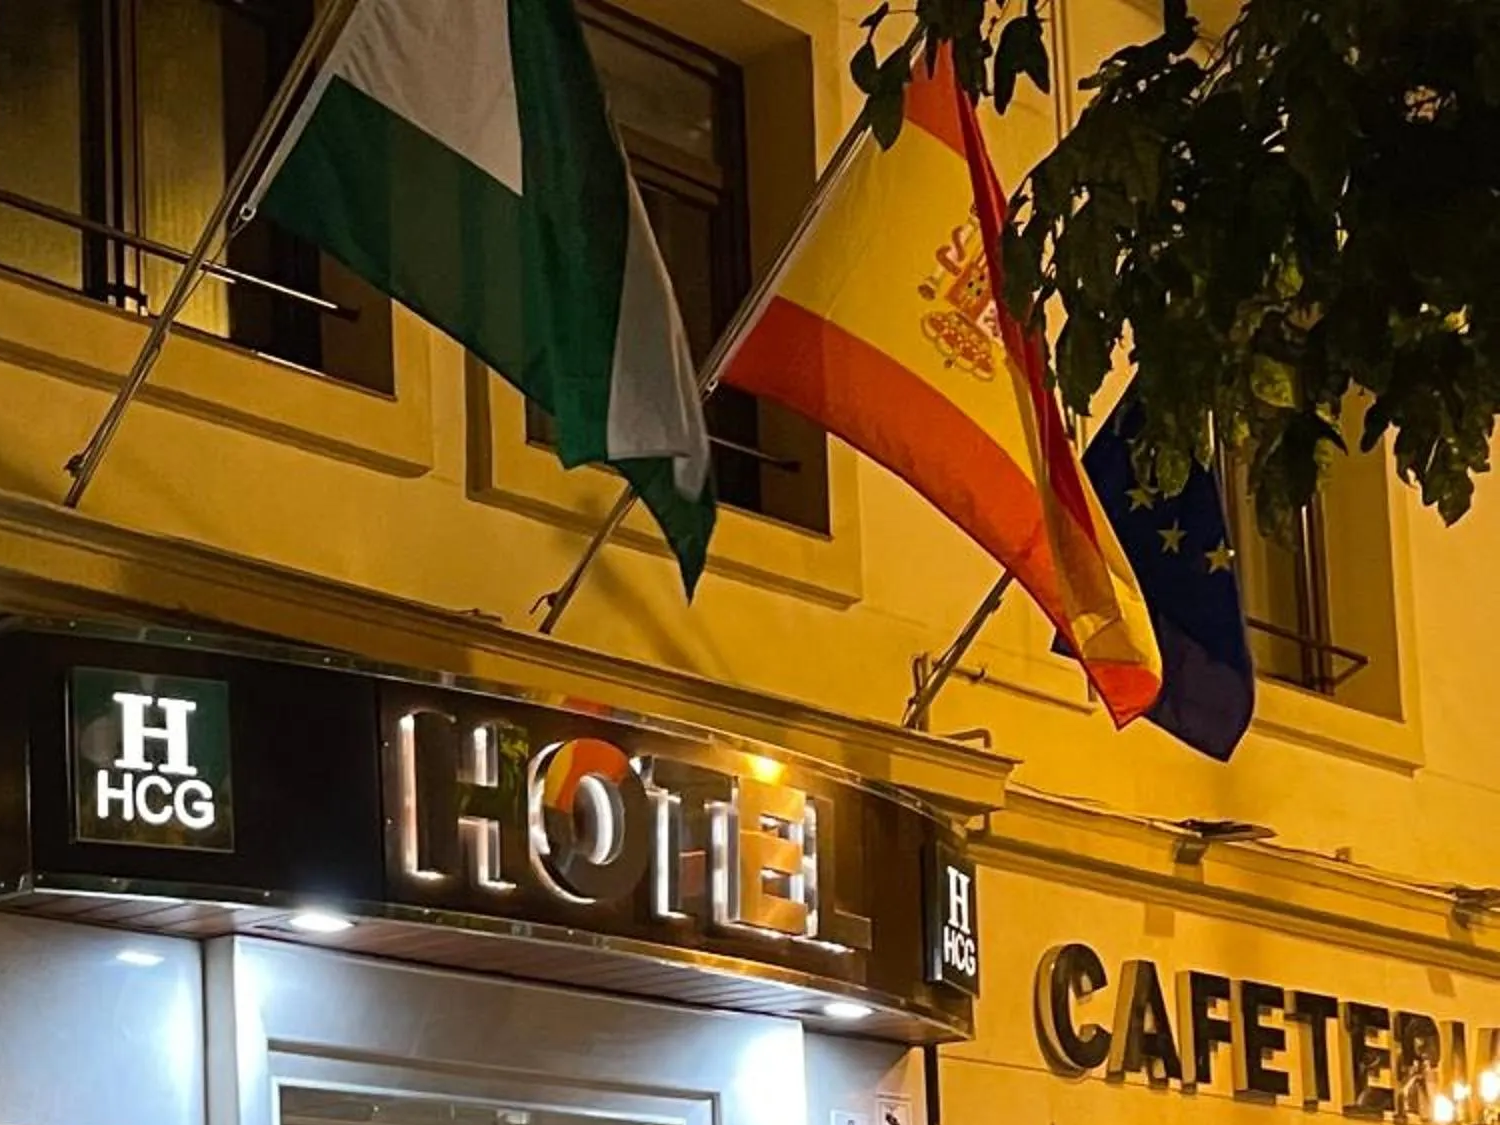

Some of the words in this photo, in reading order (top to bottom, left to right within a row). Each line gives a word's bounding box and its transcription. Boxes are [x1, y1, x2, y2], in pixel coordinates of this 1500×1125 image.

[112, 691, 198, 776] H
[97, 769, 216, 830] HCG
[398, 706, 873, 953] HOTEL
[946, 864, 971, 935] H
[943, 925, 976, 976] HCG
